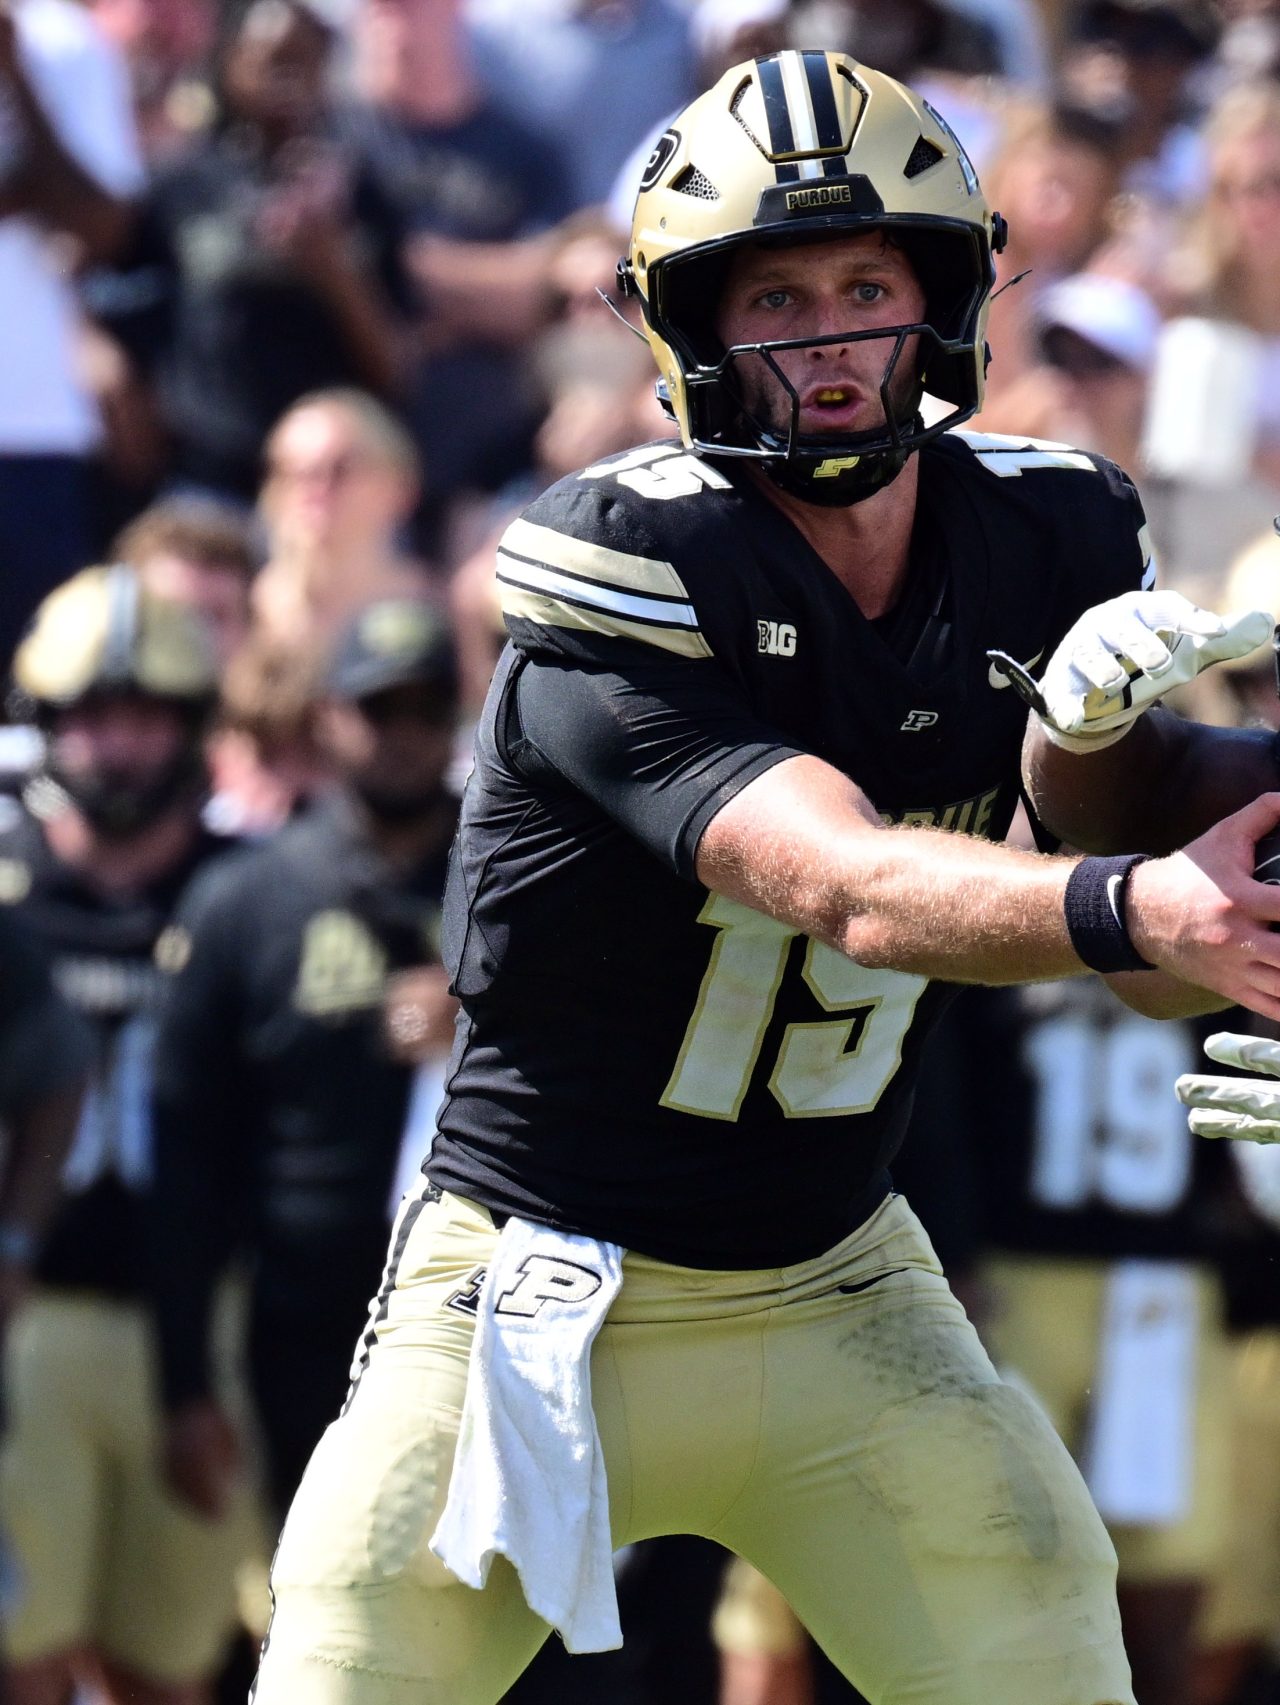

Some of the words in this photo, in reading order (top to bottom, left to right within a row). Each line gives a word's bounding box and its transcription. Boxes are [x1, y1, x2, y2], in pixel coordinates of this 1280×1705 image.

[786, 185, 851, 209] PURDUE
[900, 710, 938, 731] P
[658, 890, 930, 1122] 15
[1022, 1014, 1197, 1213] 19
[495, 1254, 602, 1317] P
